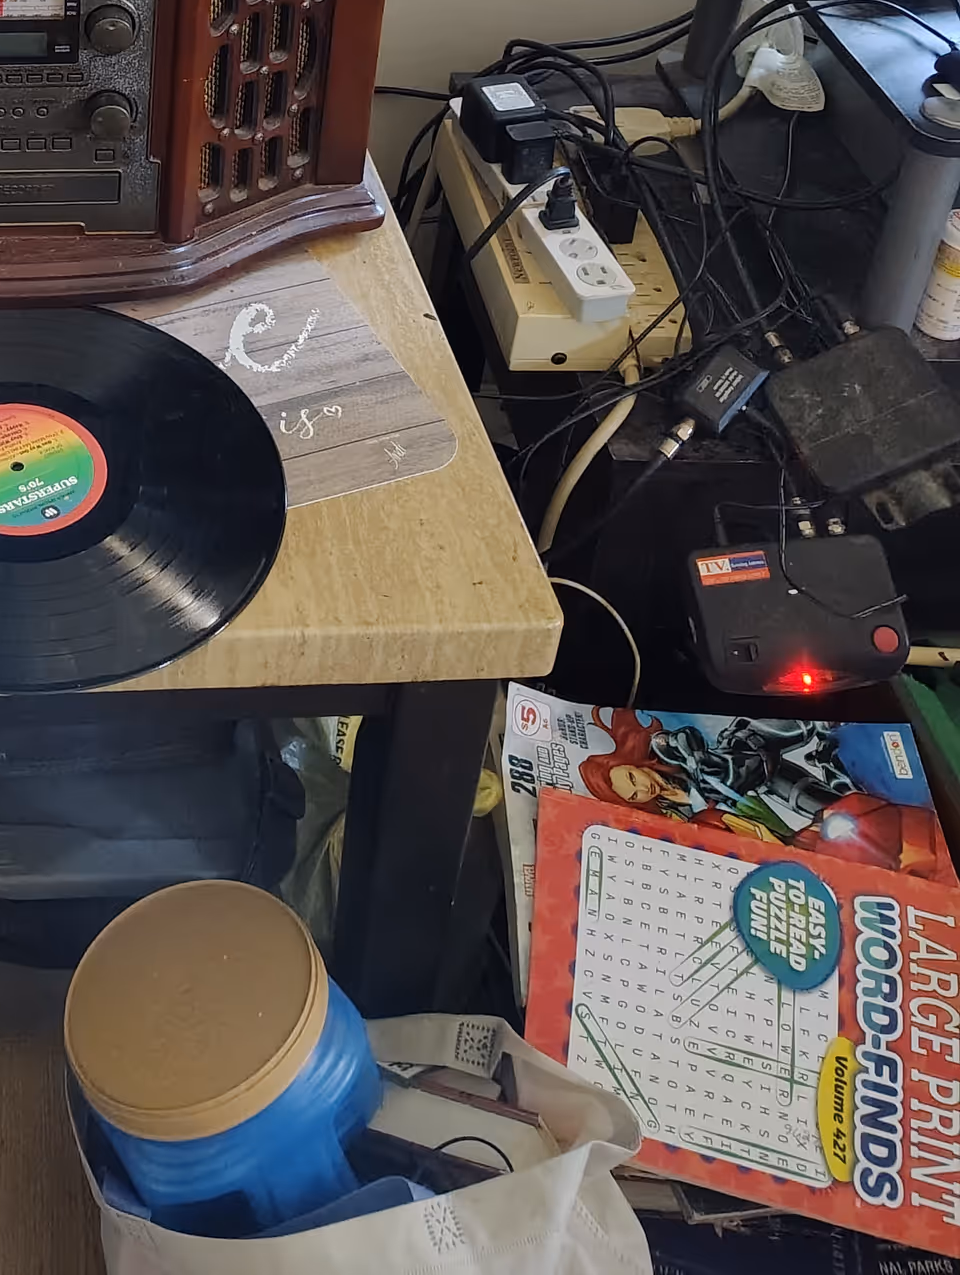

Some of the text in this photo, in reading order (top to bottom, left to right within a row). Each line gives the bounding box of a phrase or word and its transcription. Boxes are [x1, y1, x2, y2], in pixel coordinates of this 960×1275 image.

[508, 754, 538, 798] 288
[551, 743, 570, 777] Pages
[750, 887, 769, 941] FUN!
[769, 876, 788, 958] PUZZLE
[788, 878, 807, 972] TO-READ
[808, 896, 826, 960] EASY-
[856, 897, 903, 1207] WORD-FINDS
[907, 905, 960, 1227] LARGE PRINT
[831, 1056, 849, 1165] Volume 427
